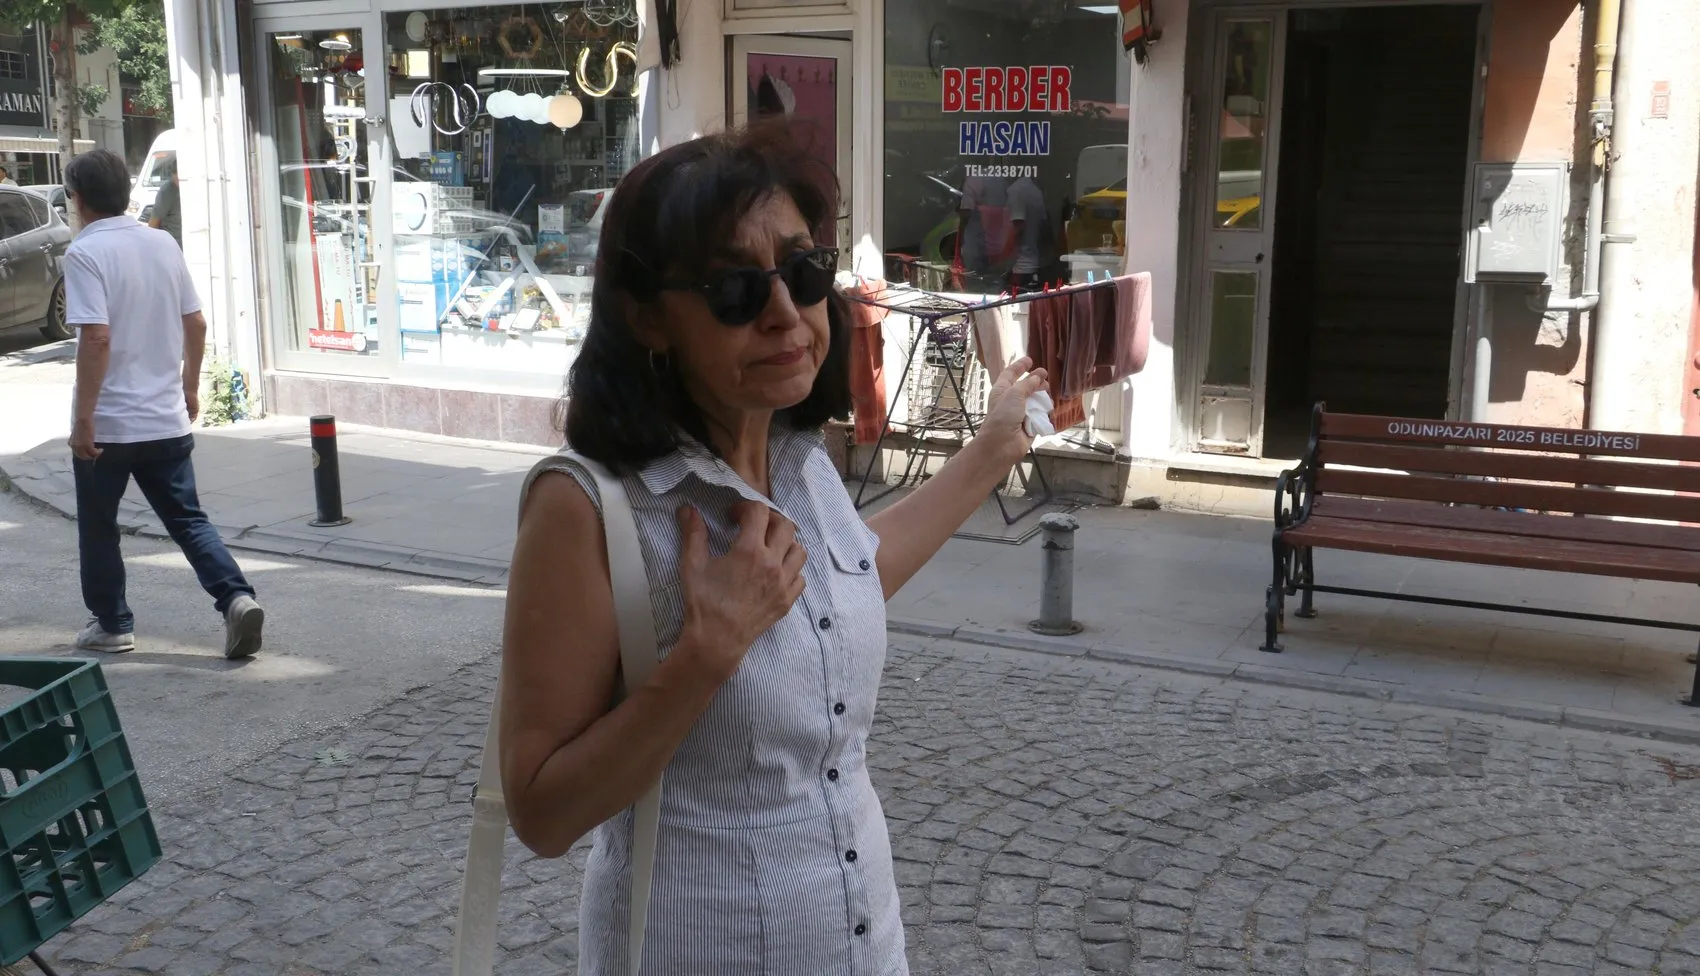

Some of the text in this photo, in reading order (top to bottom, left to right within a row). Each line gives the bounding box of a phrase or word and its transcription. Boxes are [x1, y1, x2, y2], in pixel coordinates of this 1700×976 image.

[941, 65, 1072, 112] BERBER
[959, 121, 1051, 155] HASAN
[964, 164, 1038, 178] TEL:2338701
[1387, 422, 1640, 451] ODUNPAZARI 2025 BELEDİYESİ
